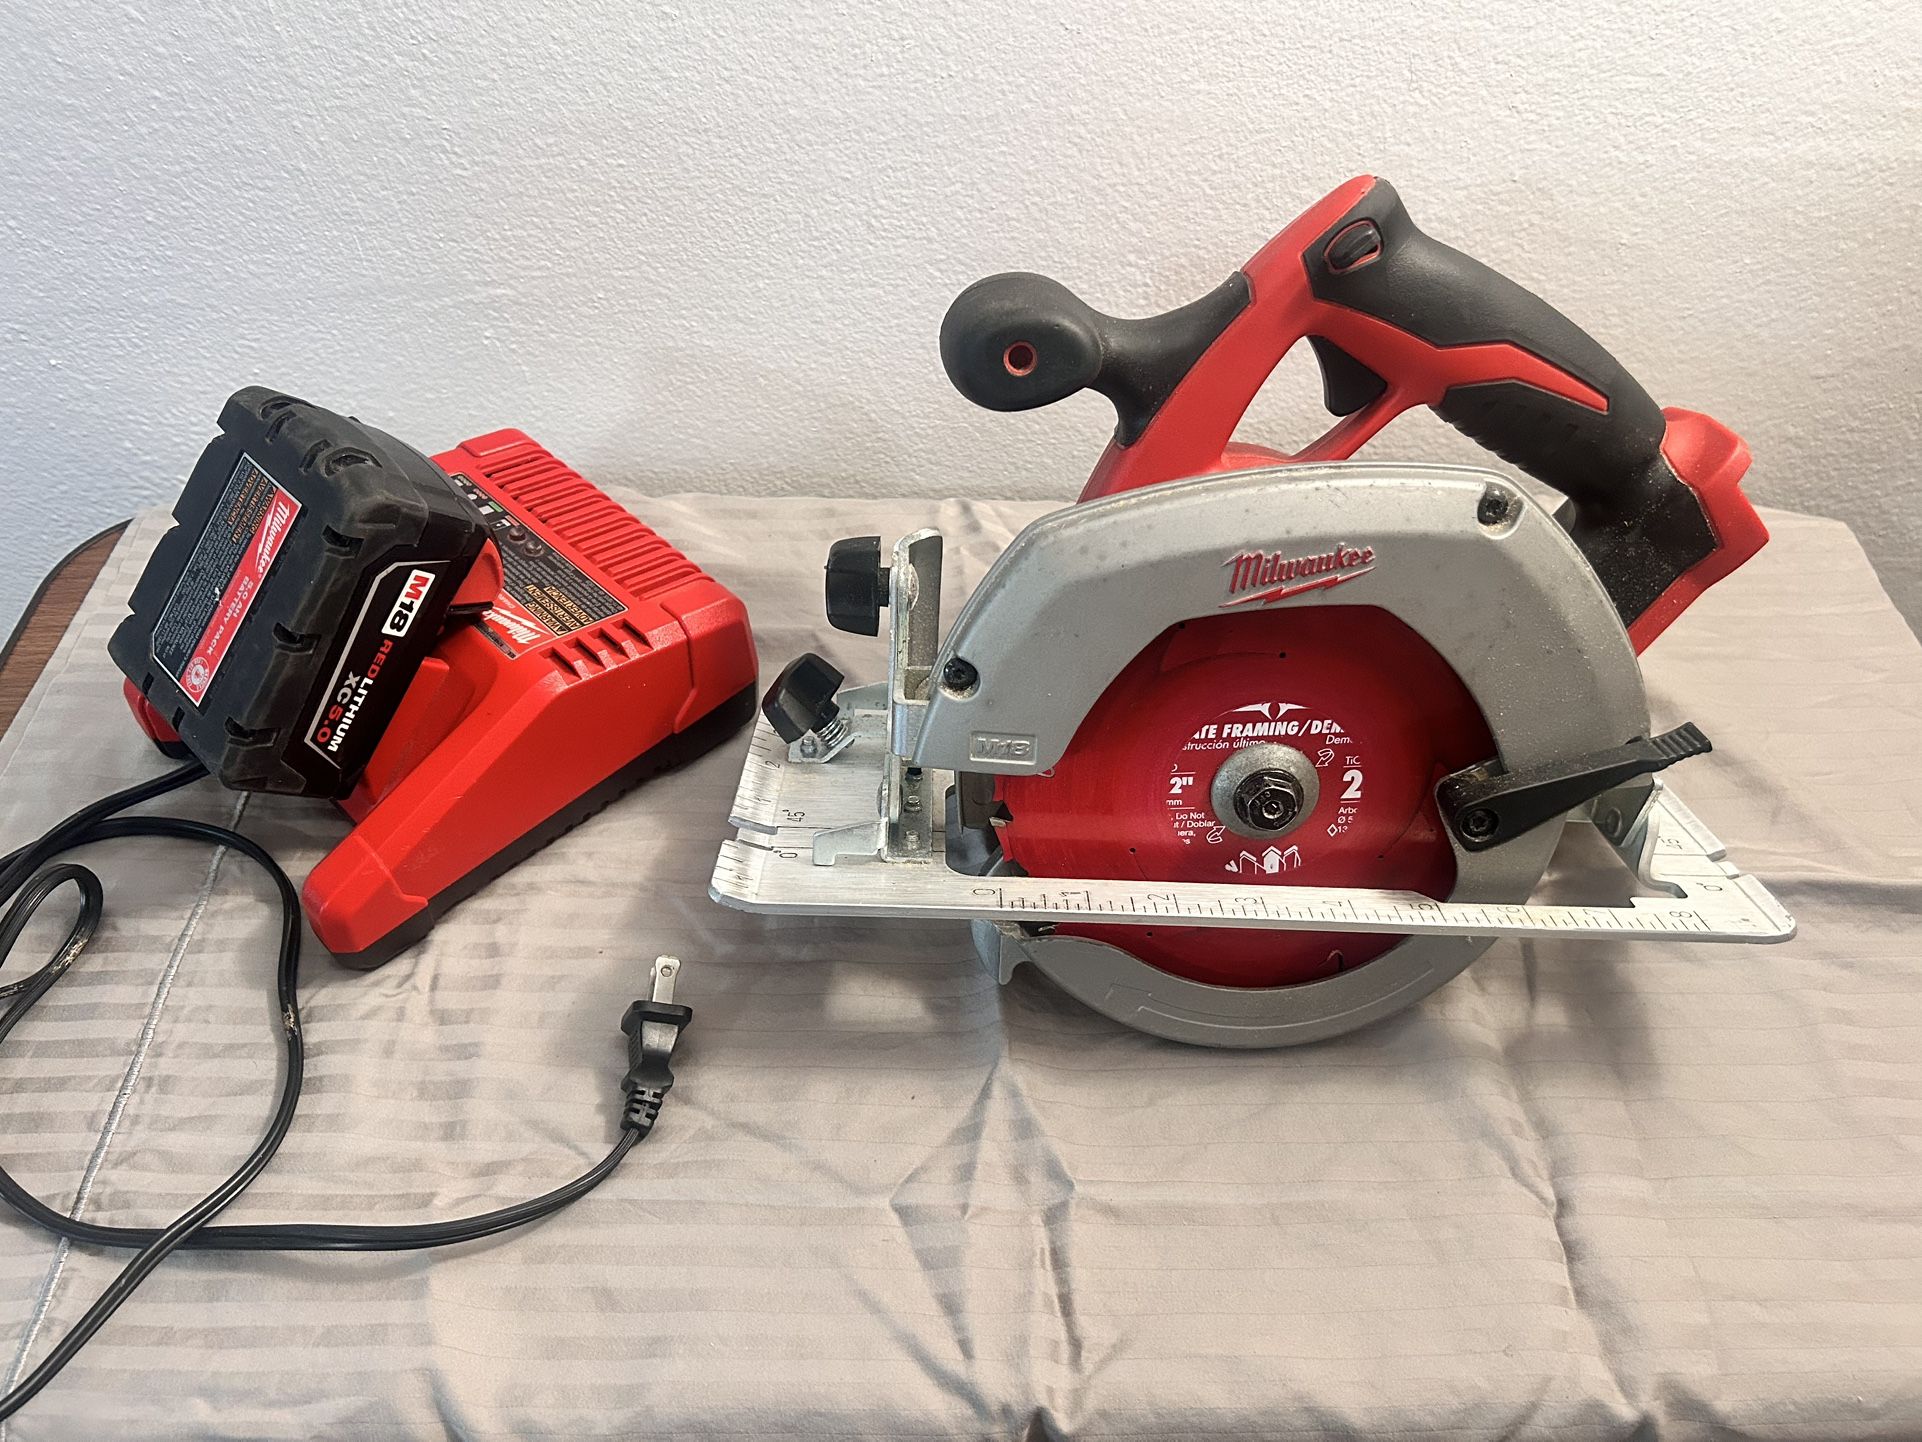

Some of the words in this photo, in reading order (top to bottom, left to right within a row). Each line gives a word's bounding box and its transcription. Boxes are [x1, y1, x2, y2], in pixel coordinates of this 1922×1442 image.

[249, 494, 271, 533] WARNING
[256, 501, 290, 576] Milwaukee
[1221, 543, 1376, 593] Milwaukee
[222, 574, 249, 623] BATTERY
[387, 574, 429, 632] M18
[524, 584, 580, 628] AVERTISSEMENT
[525, 602, 561, 630] WARNING
[544, 585, 593, 623] ADVERTENCIA
[205, 624, 224, 657] PACK
[481, 609, 540, 646] Milwauk
[326, 637, 393, 753] REDLITHIUM
[977, 737, 1030, 756] M18
[1232, 737, 1264, 749] últim
[1325, 735, 1352, 745] Dem
[1340, 769, 1363, 799] 2
[1186, 820, 1216, 828] Doblar
